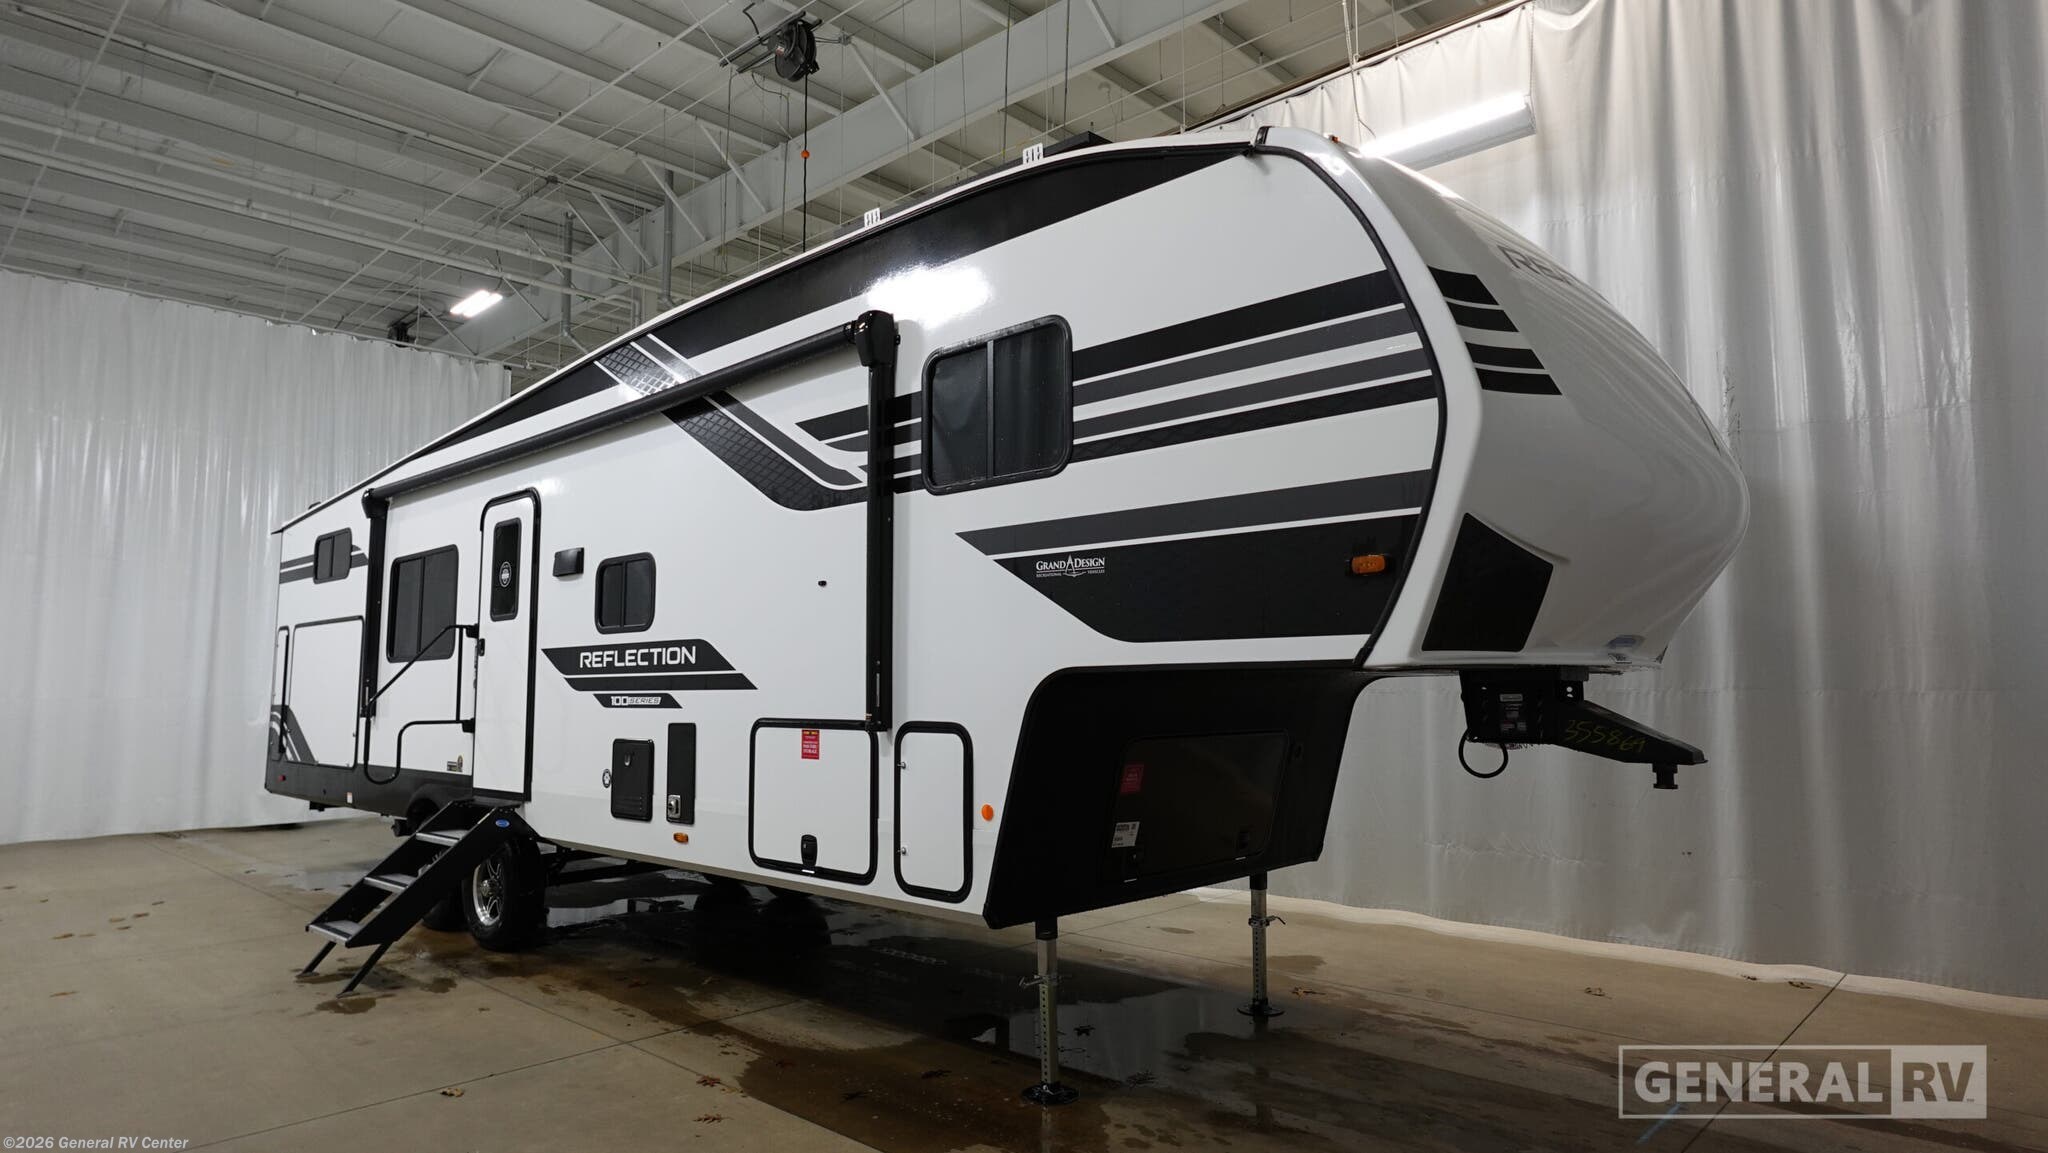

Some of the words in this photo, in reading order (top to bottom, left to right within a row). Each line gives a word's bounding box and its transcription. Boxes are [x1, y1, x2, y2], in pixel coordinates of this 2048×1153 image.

[1036, 560, 1066, 570] GRAND
[1074, 557, 1105, 568] DESIGN
[580, 646, 696, 668] REFLECTION
